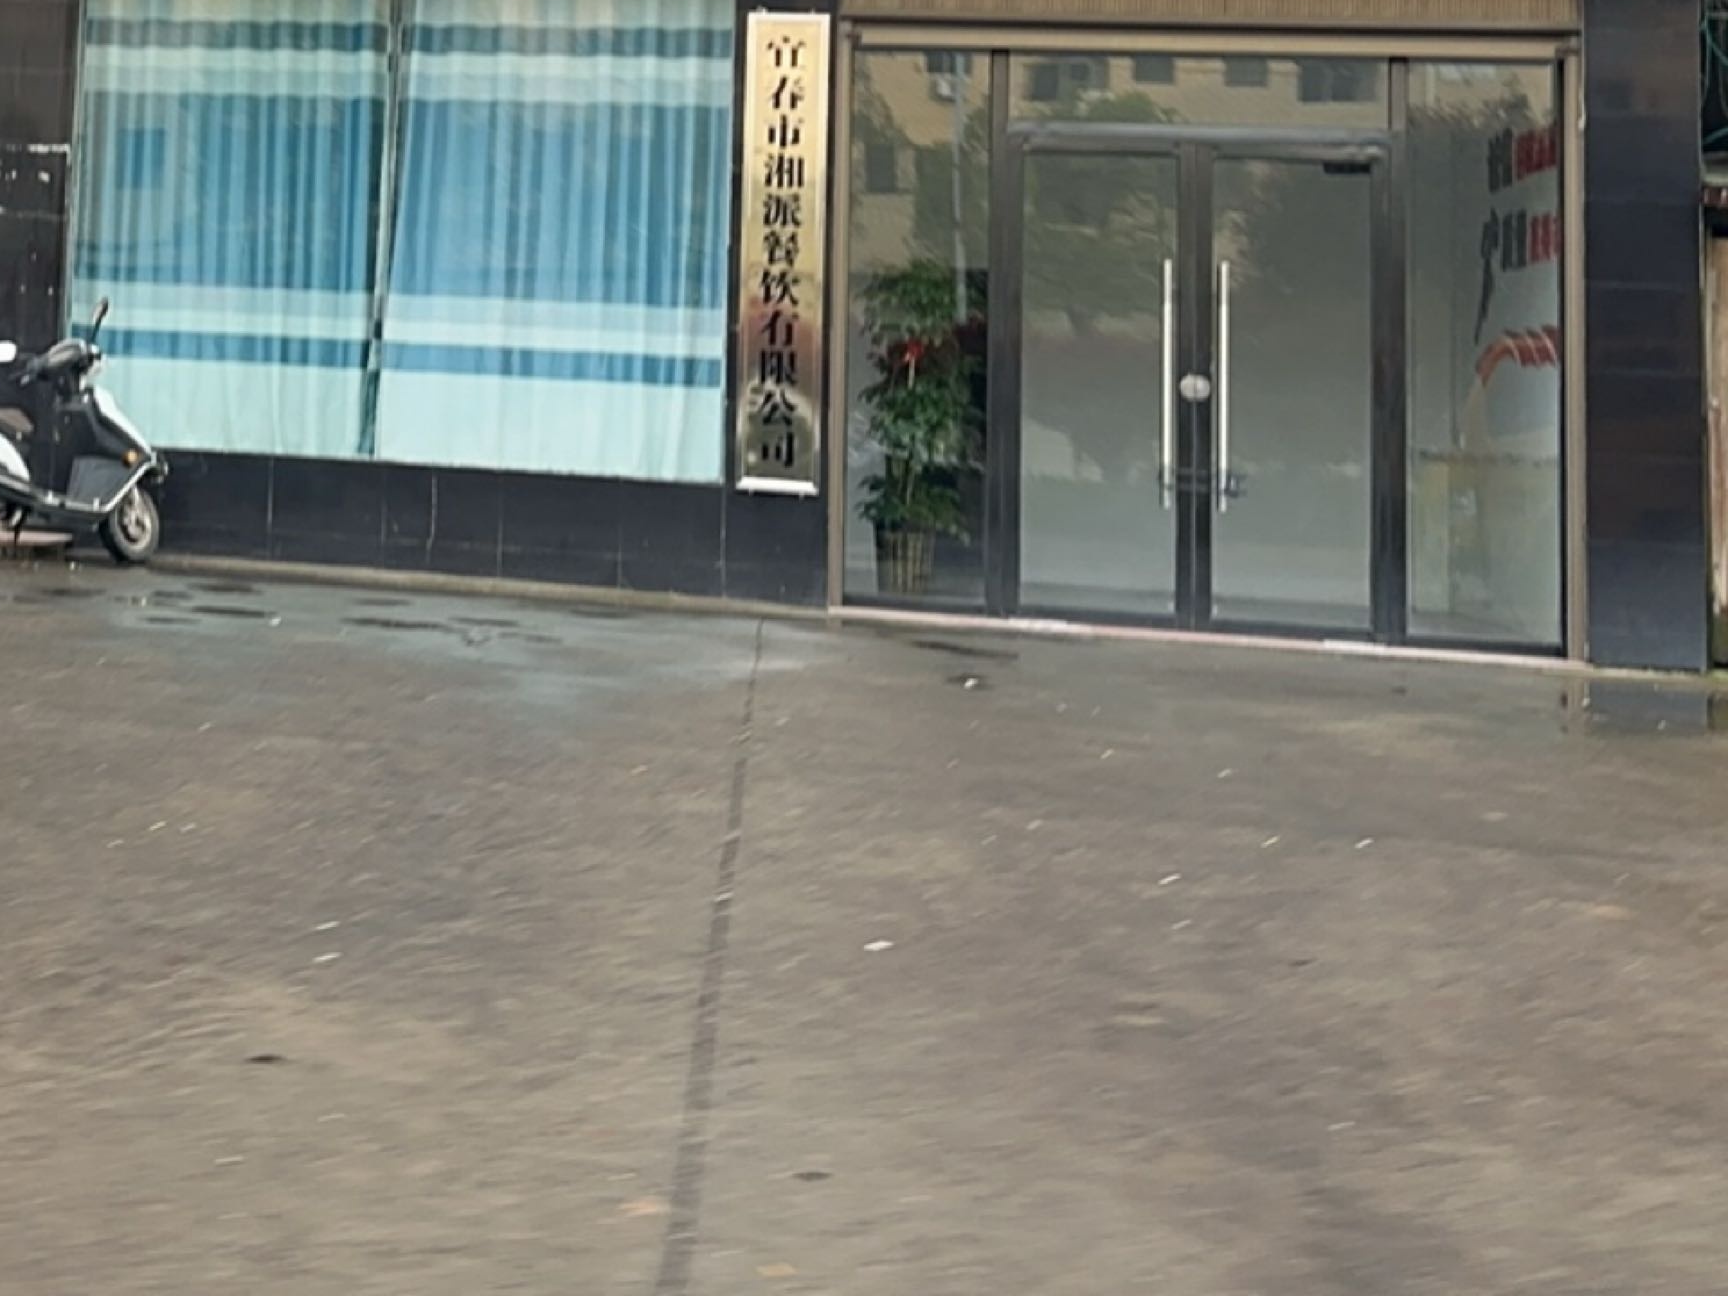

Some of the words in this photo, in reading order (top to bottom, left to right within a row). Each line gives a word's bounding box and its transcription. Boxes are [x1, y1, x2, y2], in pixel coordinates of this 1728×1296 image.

[758, 35, 807, 469] 宜春市湘派餐饮有限公司
